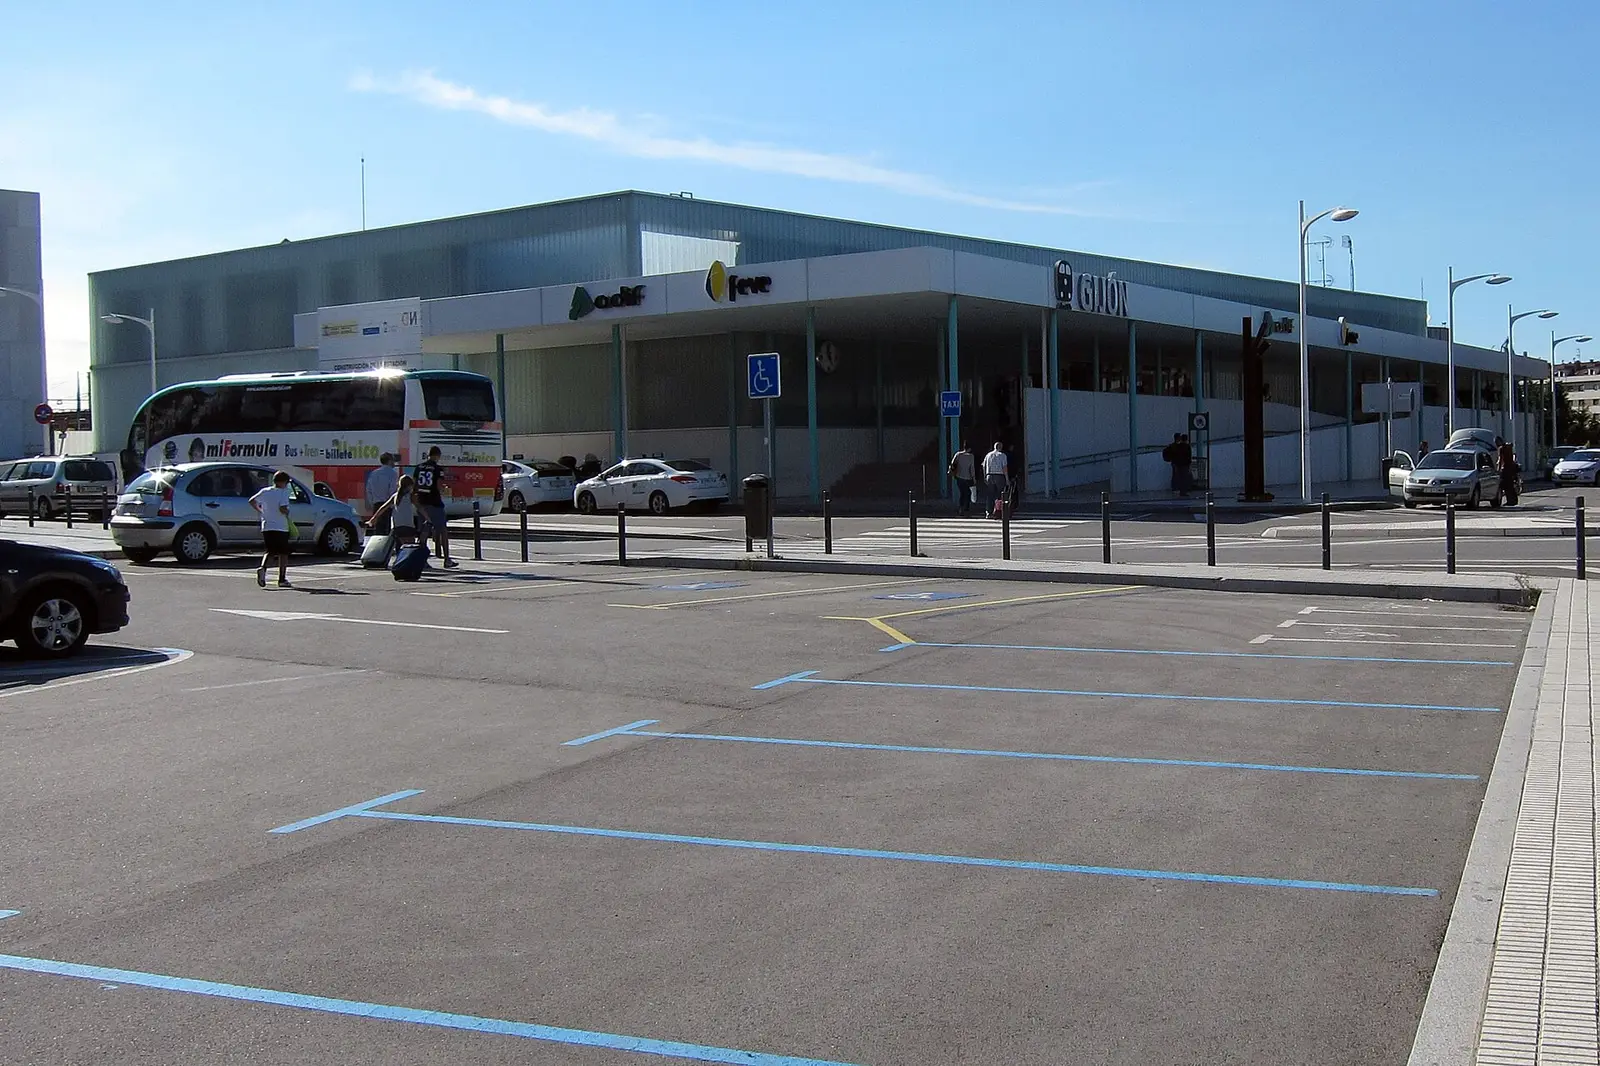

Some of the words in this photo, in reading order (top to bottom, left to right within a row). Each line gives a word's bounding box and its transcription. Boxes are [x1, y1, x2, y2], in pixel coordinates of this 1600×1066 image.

[1078, 271, 1128, 318] GIJÓN
[943, 400, 960, 409] TAXI
[205, 437, 279, 459] miFormula
[284, 444, 298, 457] Bus
[325, 448, 353, 460] billete
[417, 470, 434, 487] 53
